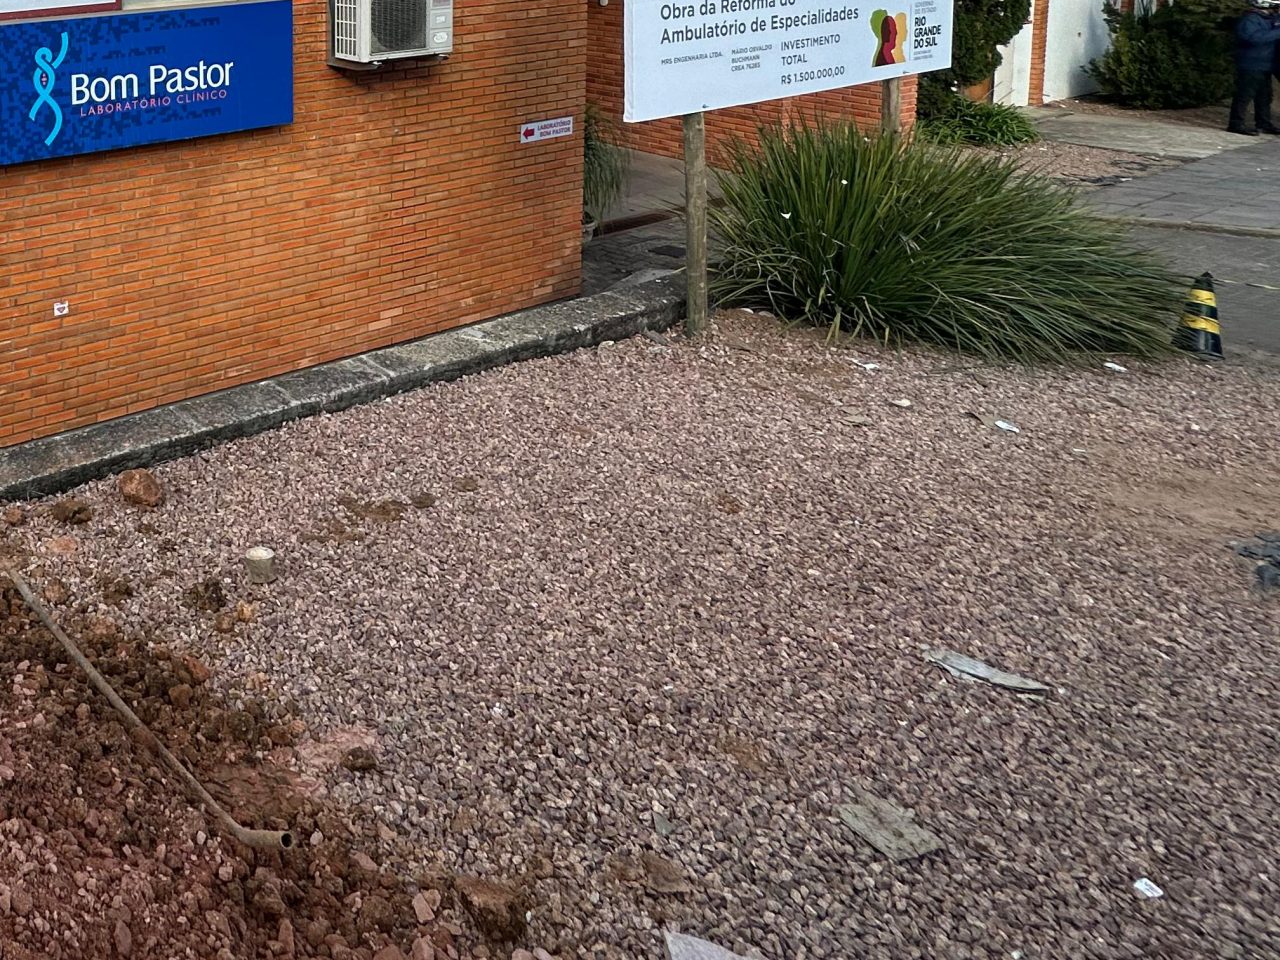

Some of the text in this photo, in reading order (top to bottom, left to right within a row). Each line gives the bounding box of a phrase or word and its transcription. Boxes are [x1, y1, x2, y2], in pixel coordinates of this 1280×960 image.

[660, 3, 695, 21] Obra
[699, 0, 717, 16] da
[660, 6, 859, 44] Ambulatório de Especialidades
[915, 16, 926, 26] RIO
[914, 25, 941, 38] GRANDE
[781, 34, 841, 51] INVESTIMENTO
[914, 37, 938, 49] DO SUL
[781, 54, 807, 66] TOTAL
[71, 60, 234, 105] Bom Pastor
[781, 66, 845, 86] R$ 1.500.000,00
[80, 89, 228, 117] LABORATÓRIO CLÍNICO
